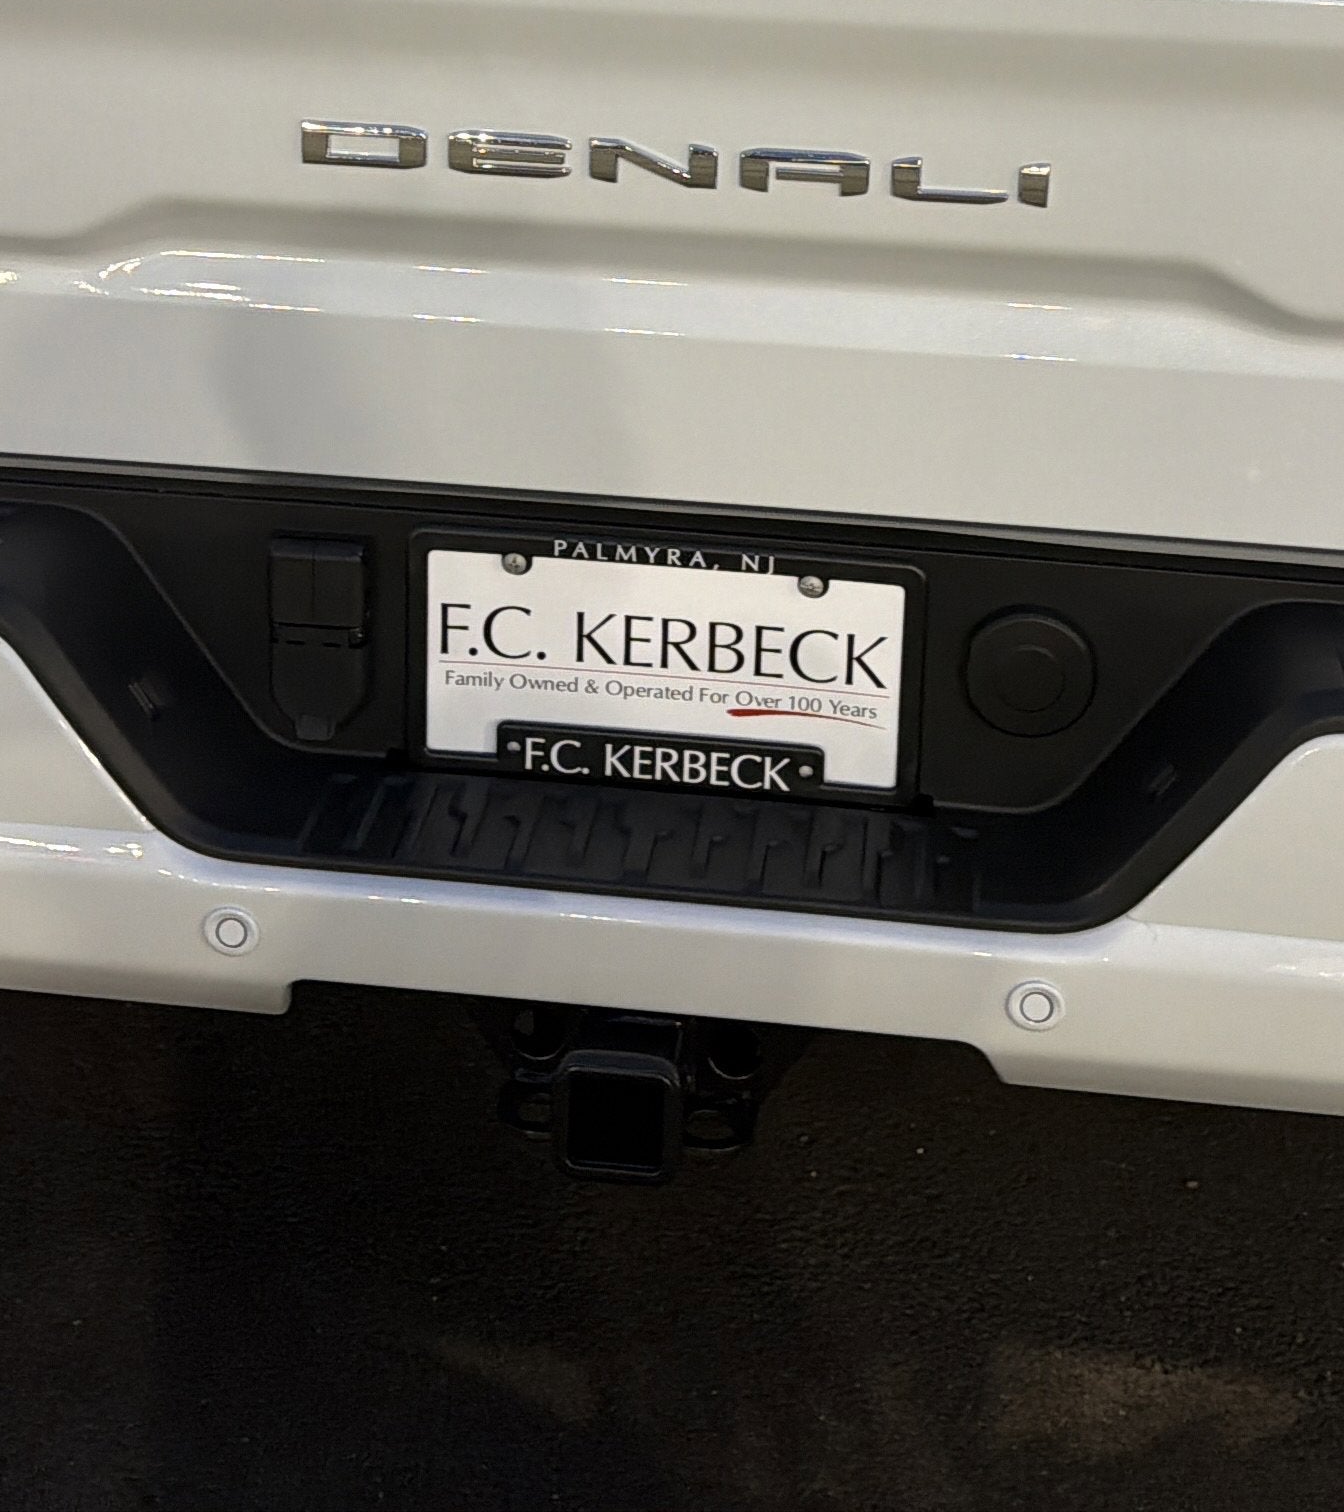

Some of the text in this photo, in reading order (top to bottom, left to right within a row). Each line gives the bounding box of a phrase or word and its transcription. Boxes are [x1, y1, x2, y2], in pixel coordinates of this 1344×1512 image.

[301, 119, 1052, 207] DENALI
[553, 539, 774, 575] PALMYRA, NJ
[439, 603, 888, 689] F.C. KERBECK
[444, 670, 878, 719] Family Owned & Operated For Over 100 Years
[524, 737, 790, 791] F.C. KERBECK
